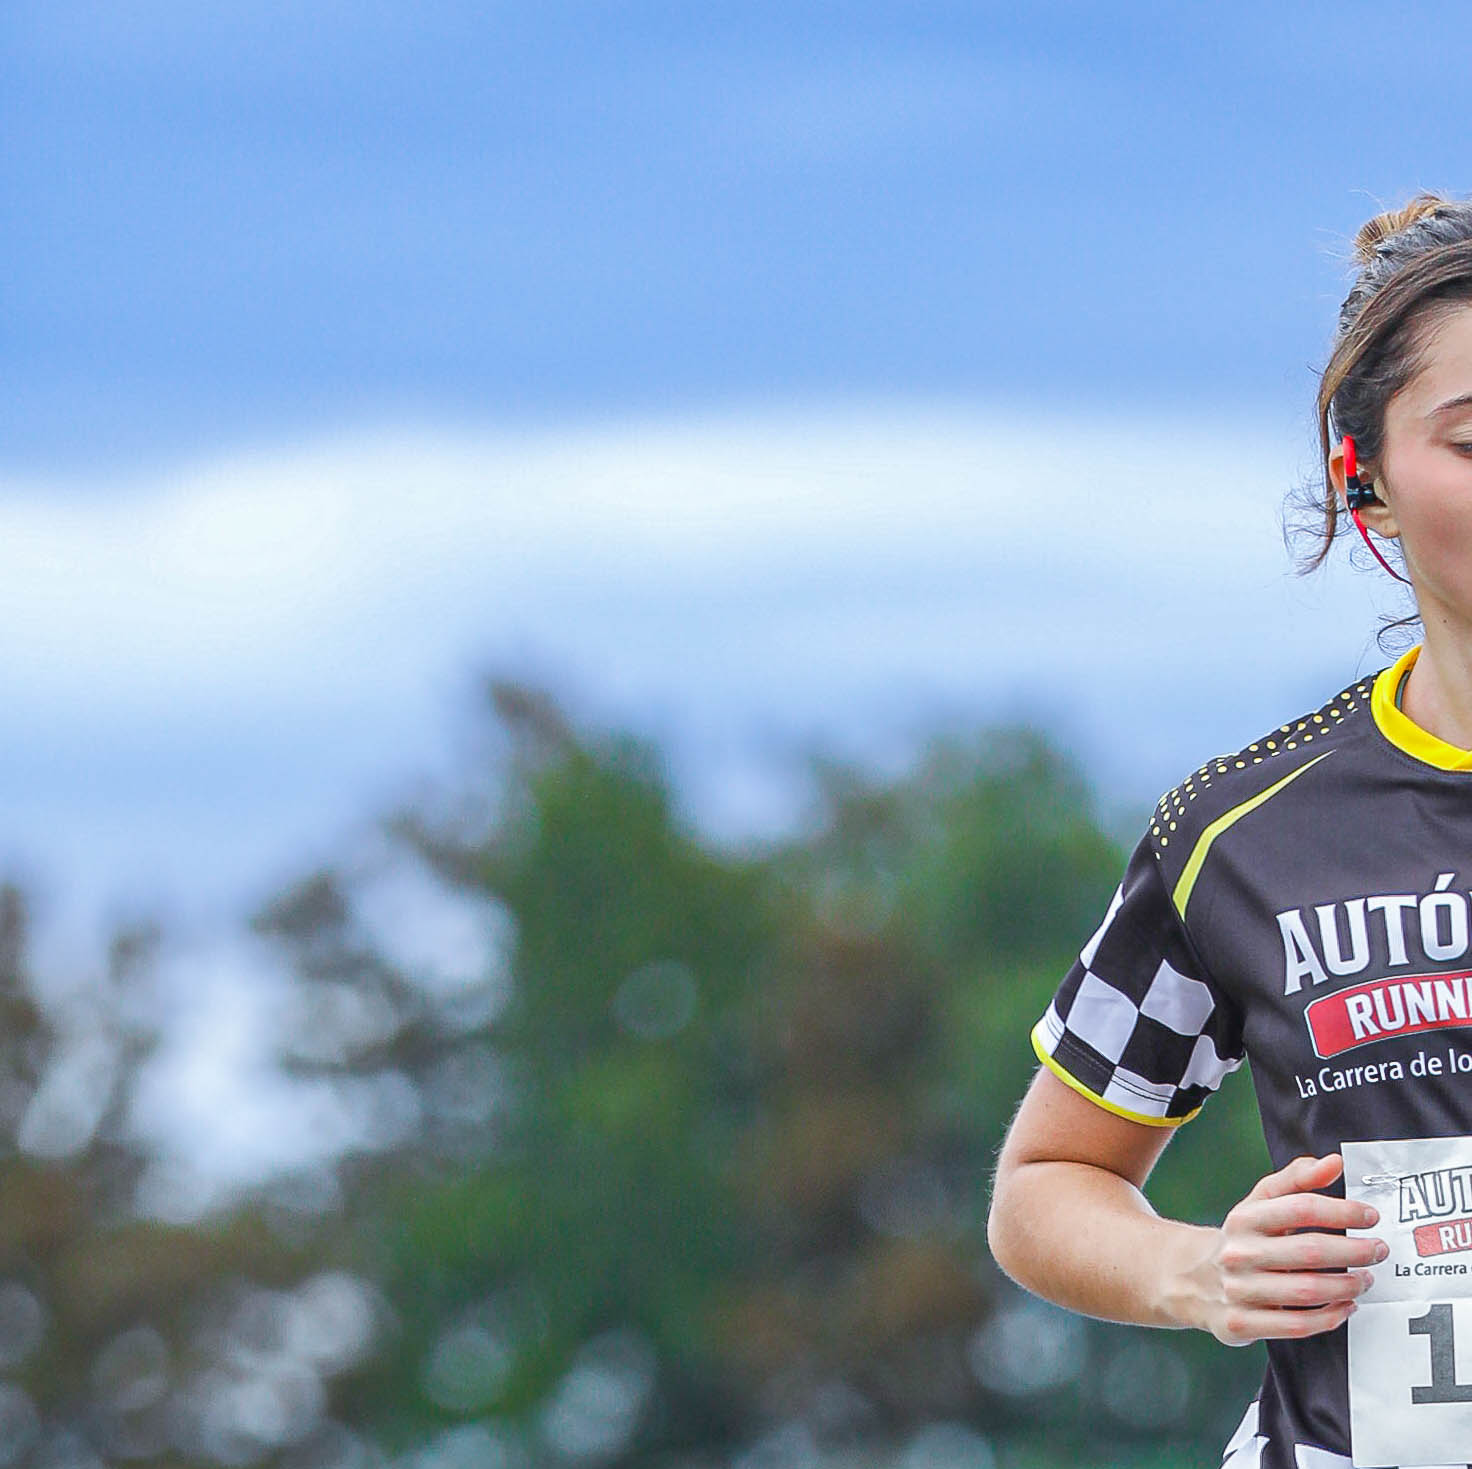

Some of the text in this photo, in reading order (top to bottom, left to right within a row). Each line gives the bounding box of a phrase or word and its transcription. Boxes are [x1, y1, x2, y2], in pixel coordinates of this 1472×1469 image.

[1295, 1074, 1318, 1099] La
[1319, 1057, 1404, 1093] Carrera
[1411, 1052, 1443, 1078] de
[1395, 1263, 1411, 1277] La
[1414, 1262, 1468, 1276] Carrera
